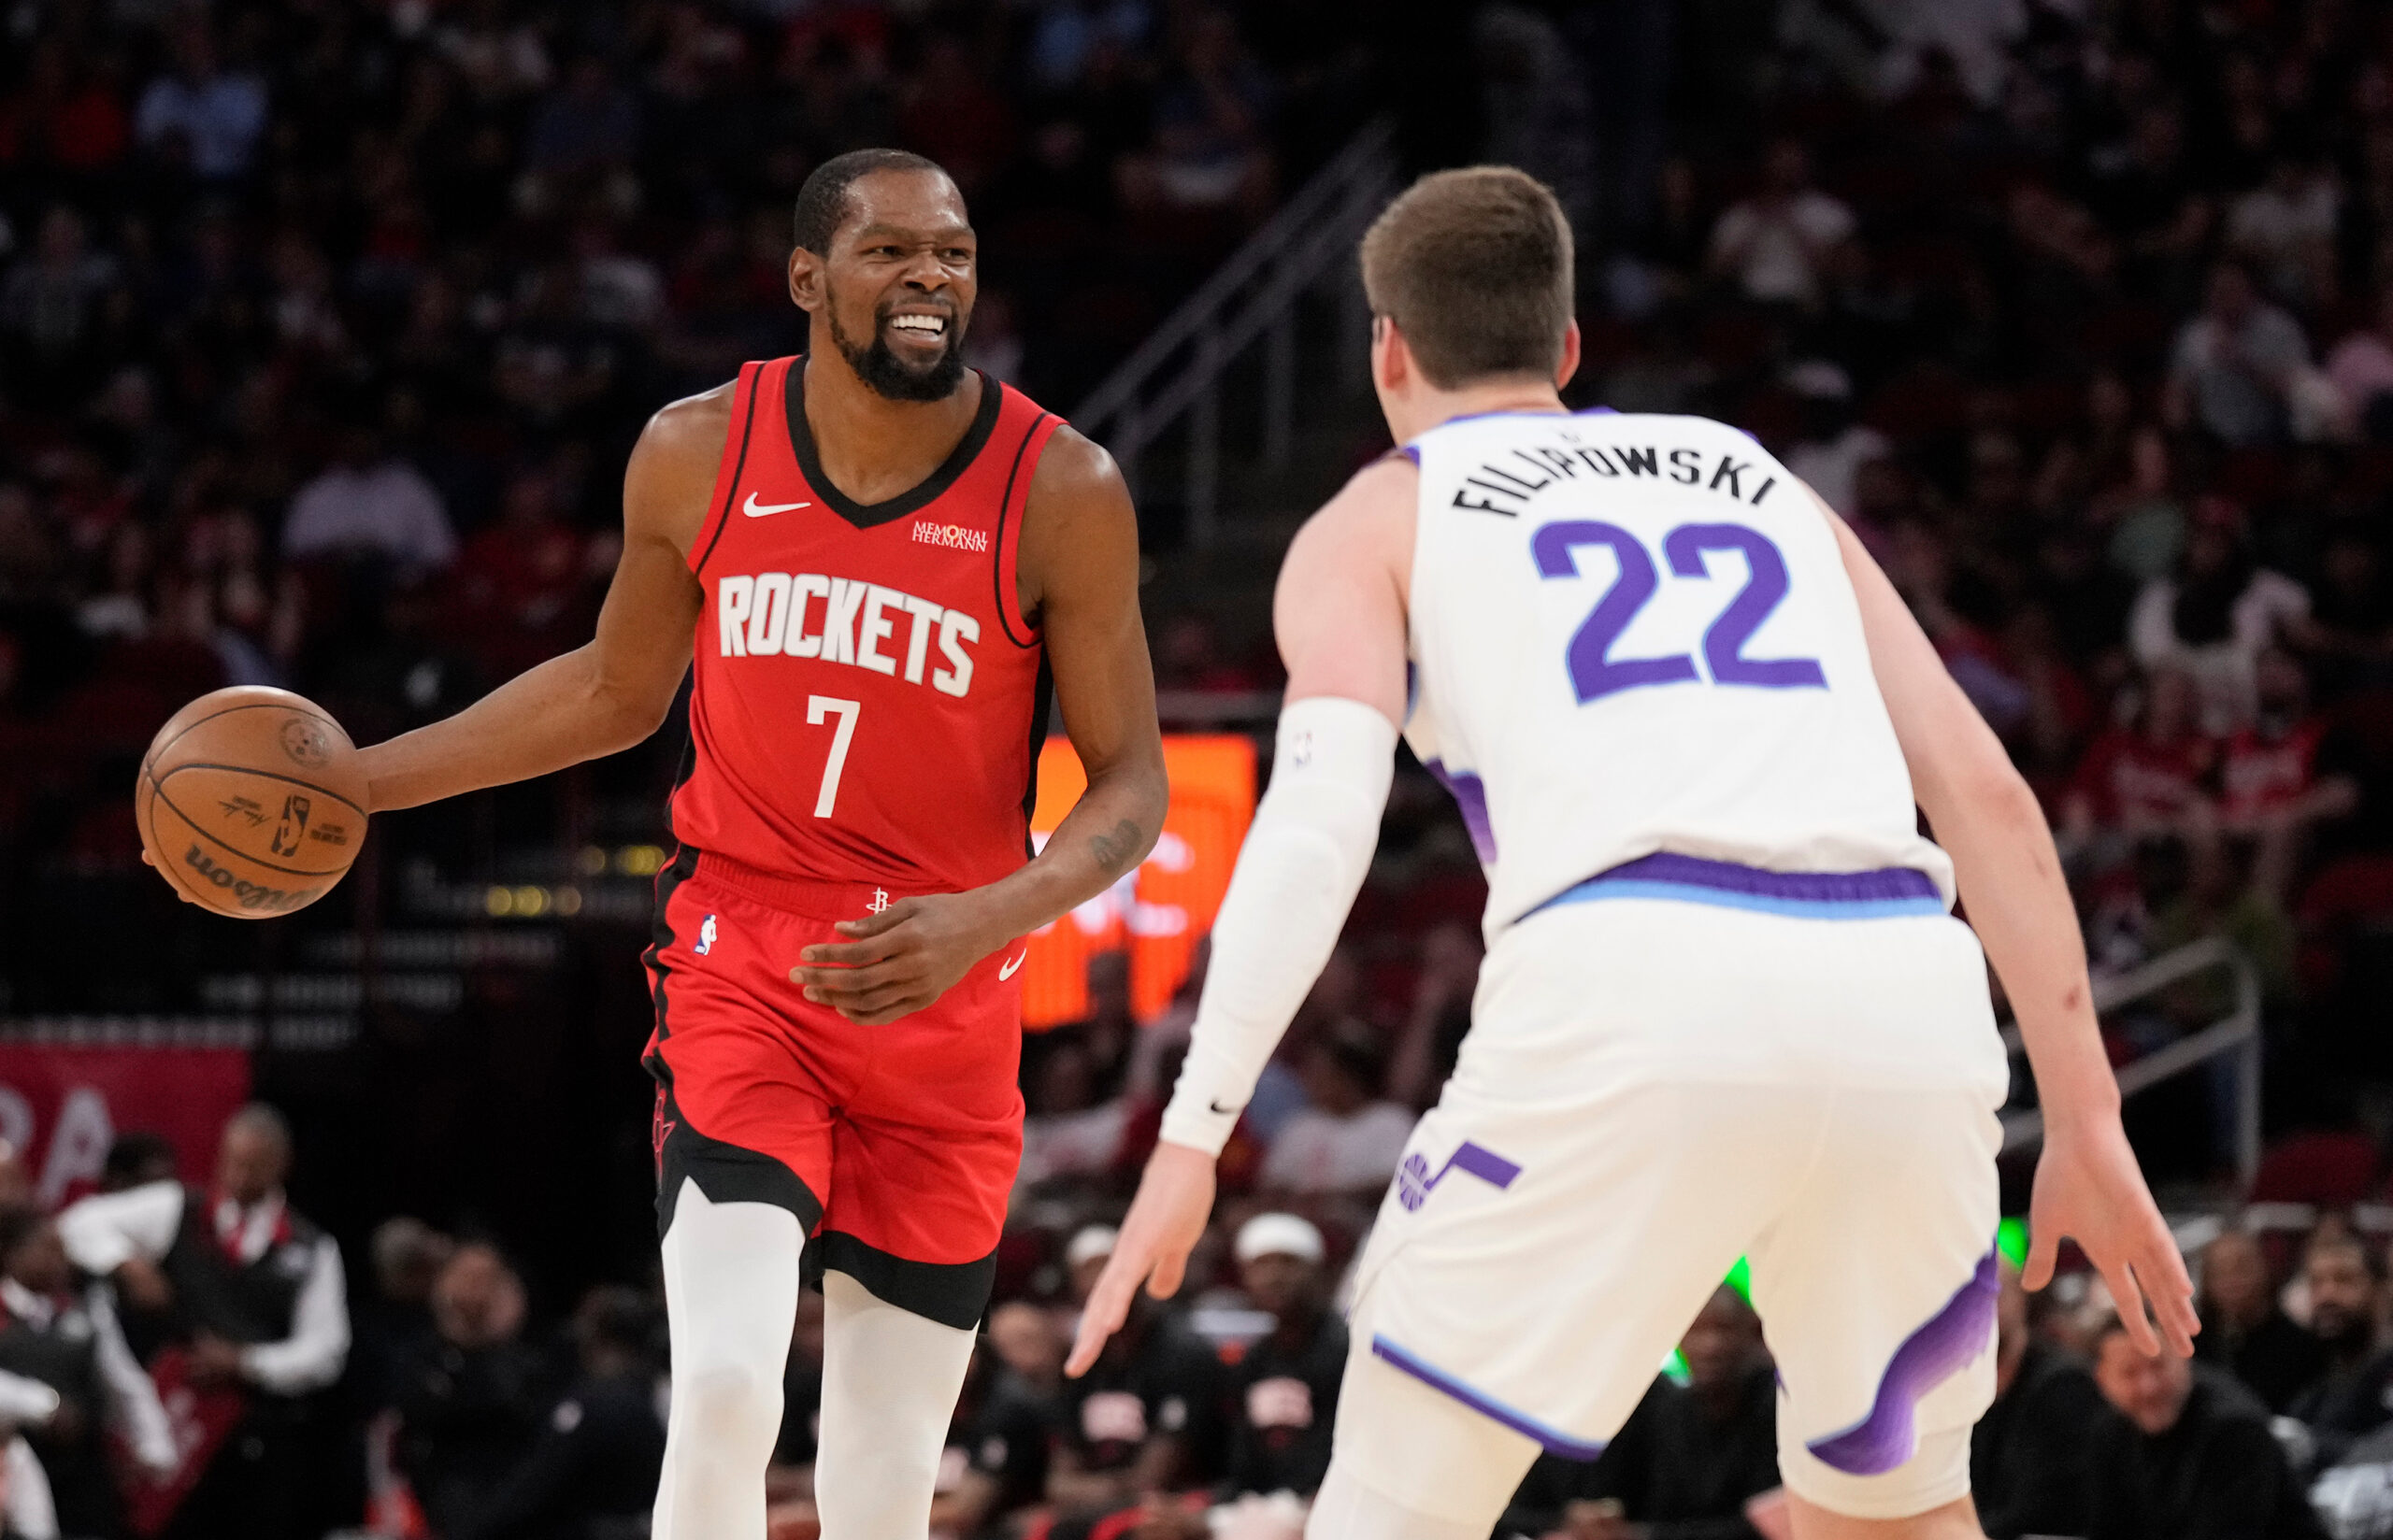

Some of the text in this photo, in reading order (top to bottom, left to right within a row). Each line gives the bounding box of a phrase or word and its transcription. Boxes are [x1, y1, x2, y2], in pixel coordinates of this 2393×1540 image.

[1452, 446, 1776, 518] FILIPOWSKI
[911, 530, 988, 552] HERMANN
[913, 520, 988, 544] MEMORIAL
[718, 572, 982, 698] ROCKETS
[1529, 520, 1830, 706] 22
[807, 694, 861, 819] 7
